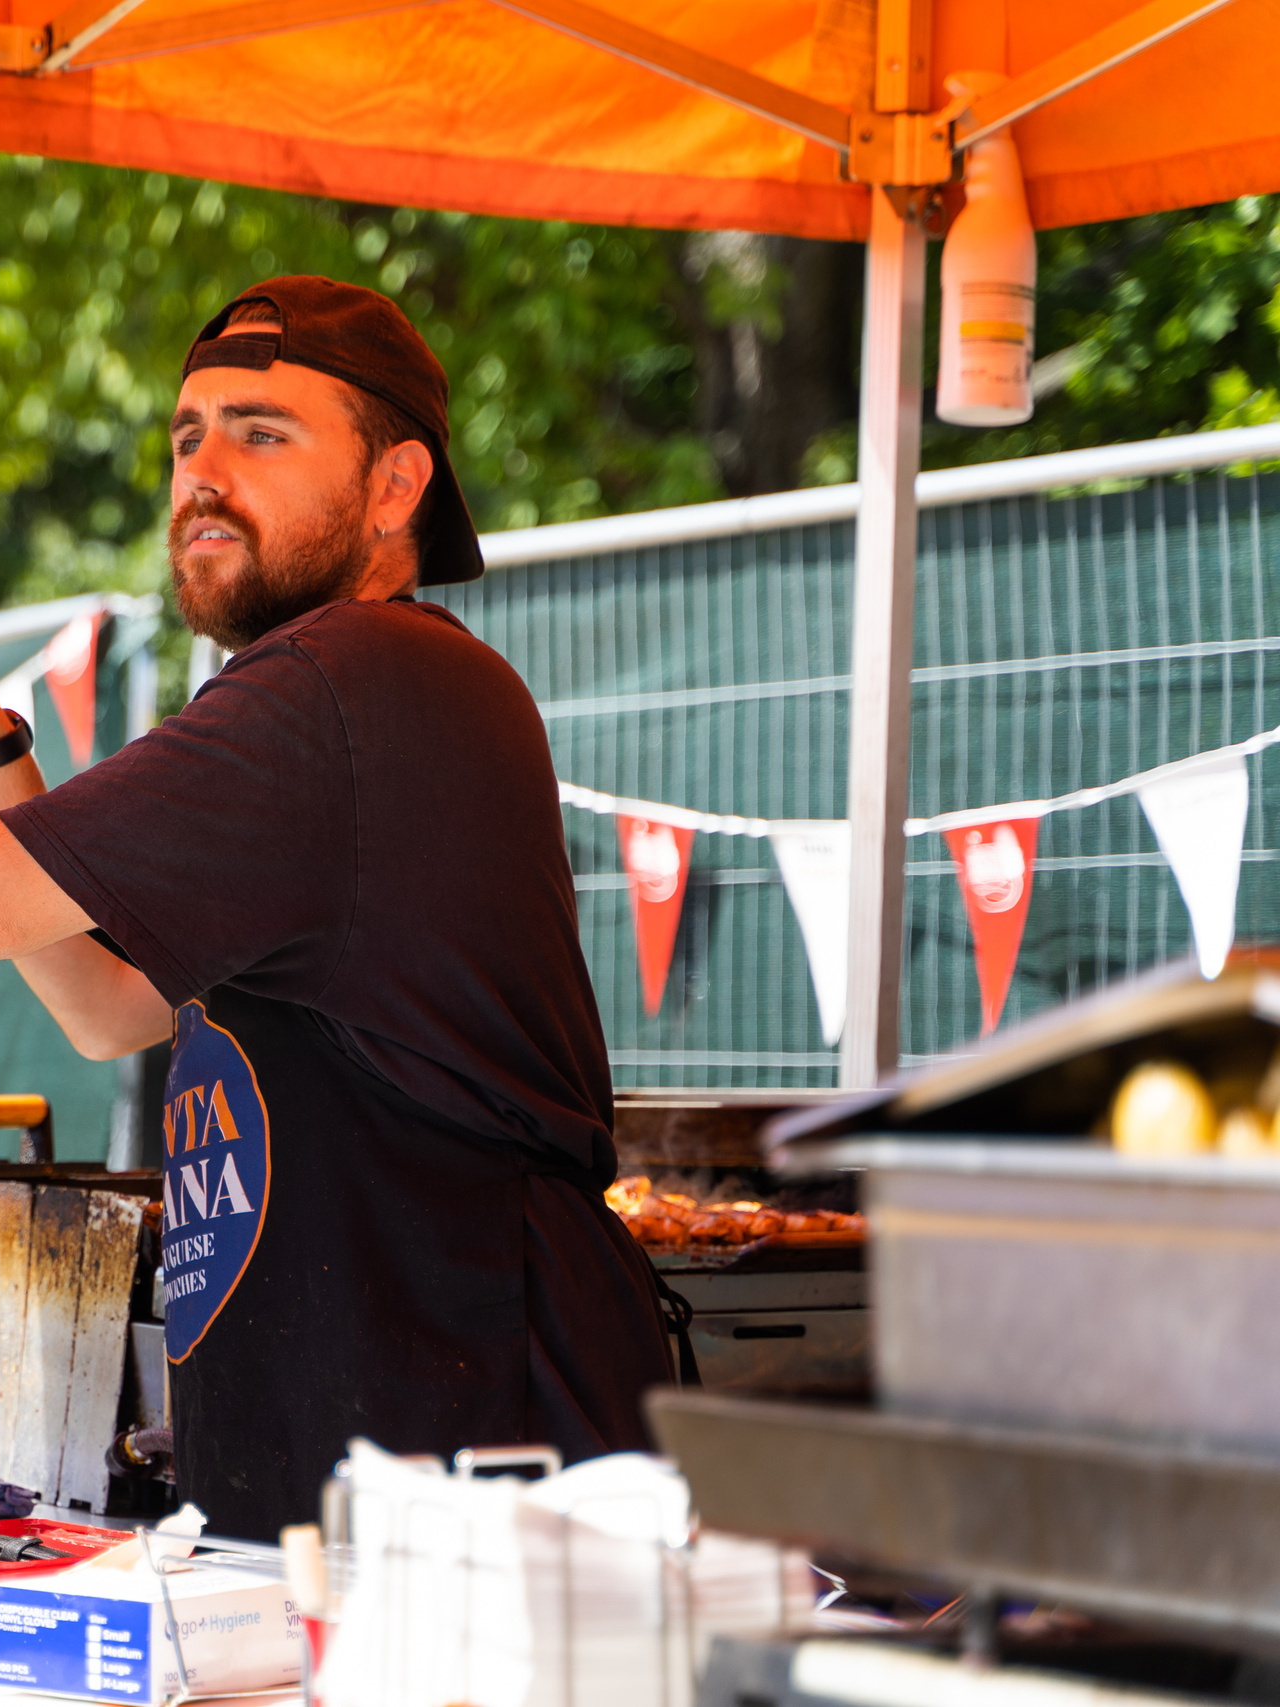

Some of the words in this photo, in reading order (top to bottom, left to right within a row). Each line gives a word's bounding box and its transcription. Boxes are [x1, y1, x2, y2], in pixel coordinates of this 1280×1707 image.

[50, 1608, 80, 1622] CLEAR
[23, 1616, 58, 1629] GLOVES
[24, 1625, 37, 1635] free
[102, 1629, 130, 1642] Small
[102, 1645, 143, 1660] Medium
[12, 1664, 30, 1675] PCS
[102, 1662, 132, 1677] Large
[164, 1672, 179, 1682] 100
[102, 1677, 140, 1694] X-Large
